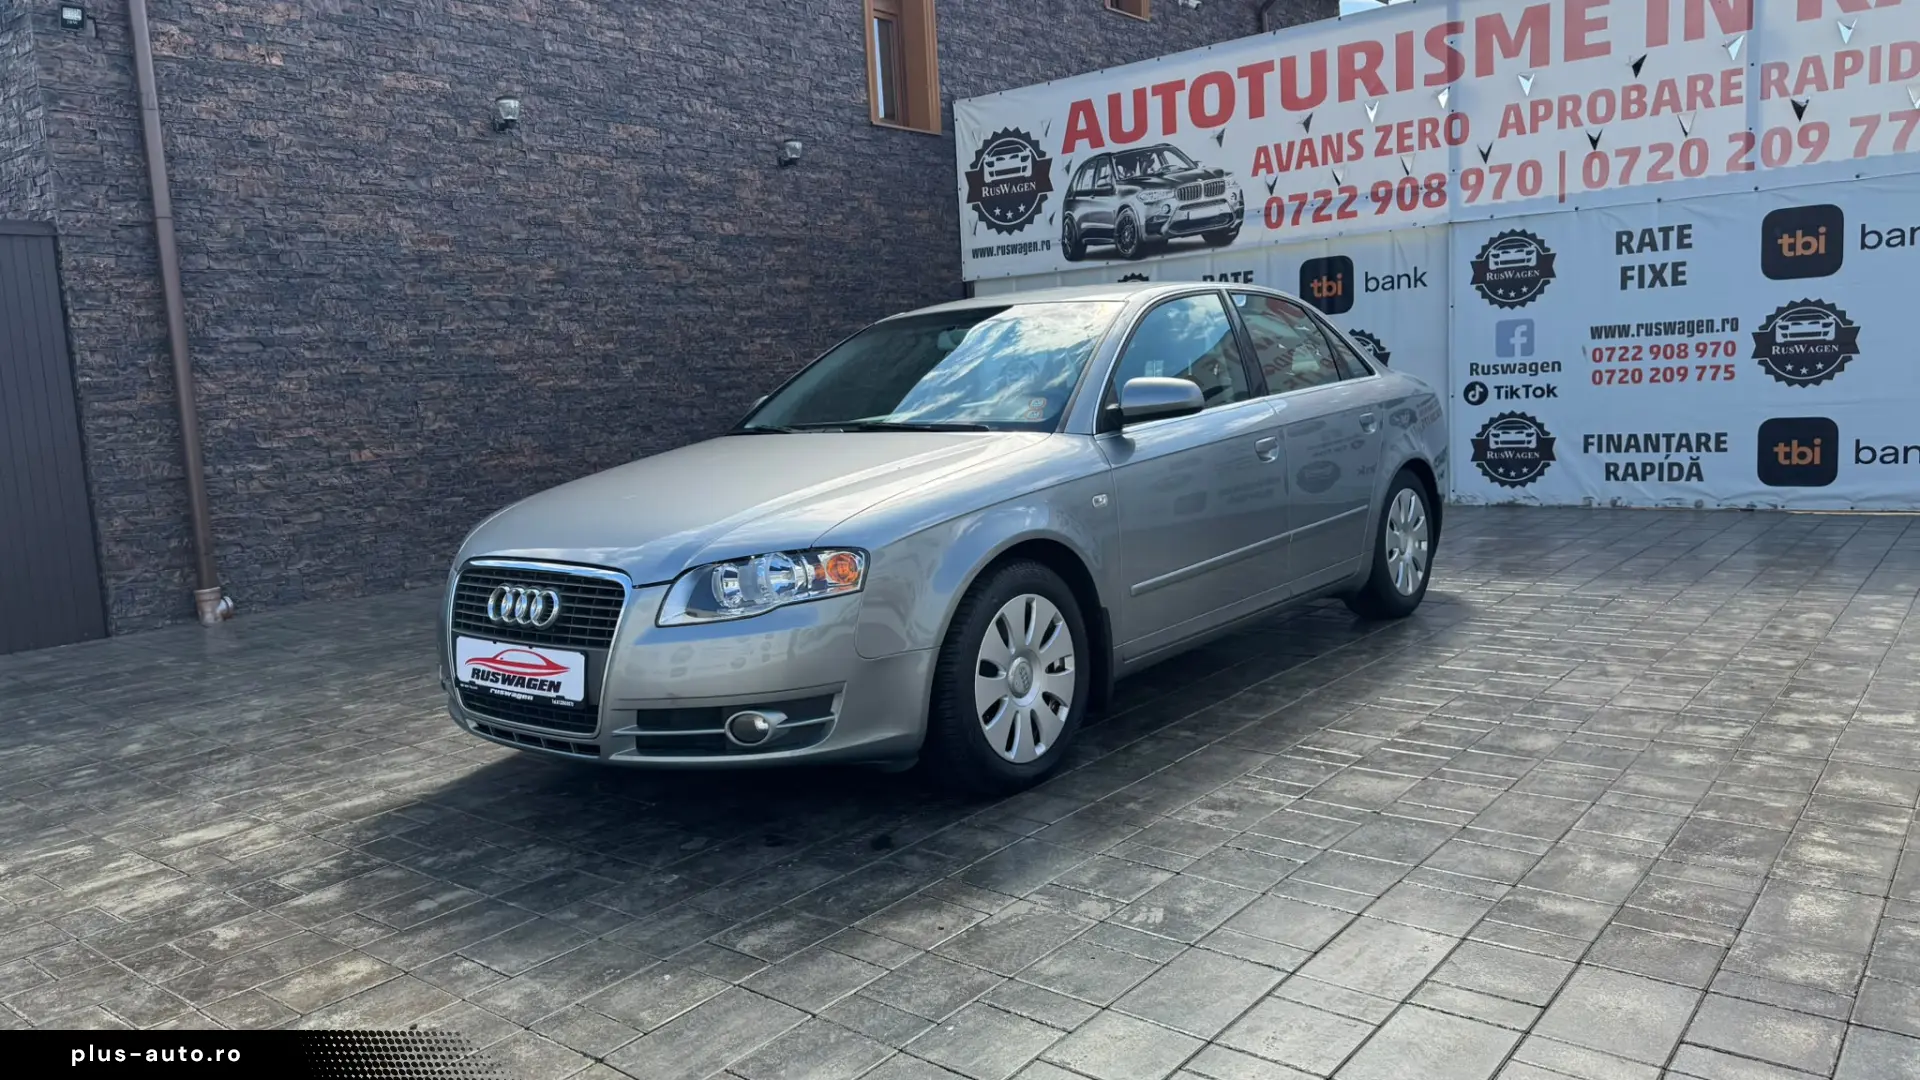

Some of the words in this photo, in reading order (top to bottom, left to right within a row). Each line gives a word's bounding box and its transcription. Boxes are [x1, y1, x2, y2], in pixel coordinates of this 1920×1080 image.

[1061, 0, 1611, 155] AUTOTURISME
[1251, 129, 1364, 177] AVANS
[1374, 111, 1470, 157] ZERO
[1498, 67, 1744, 139] APROBARE
[1264, 184, 1358, 229] 0722
[1370, 172, 1448, 215] 908
[1460, 159, 1543, 204] 970
[1582, 137, 1709, 189] 0720
[1726, 121, 1830, 172] 209
[971, 240, 1051, 260] www.ruswagen.ro
[1615, 224, 1693, 255] RATE
[1777, 227, 1827, 257] tbi
[1310, 273, 1343, 299] tbi
[1364, 266, 1428, 293] bank
[1620, 260, 1687, 290] FIXE
[1590, 317, 1740, 340] www.ruswagen.ro
[1592, 345, 1643, 364] 0722
[1649, 343, 1689, 362] 908
[1695, 340, 1737, 359] 970
[1469, 358, 1562, 378] Ruswagen
[1592, 368, 1643, 386] 0720
[1649, 366, 1689, 384] 209
[1695, 363, 1736, 382] 775
[1494, 384, 1558, 401] TikTok
[1773, 439, 1822, 466] tbi
[470, 667, 562, 694] RUSWAGEN
[489, 687, 534, 701] ruswagen
